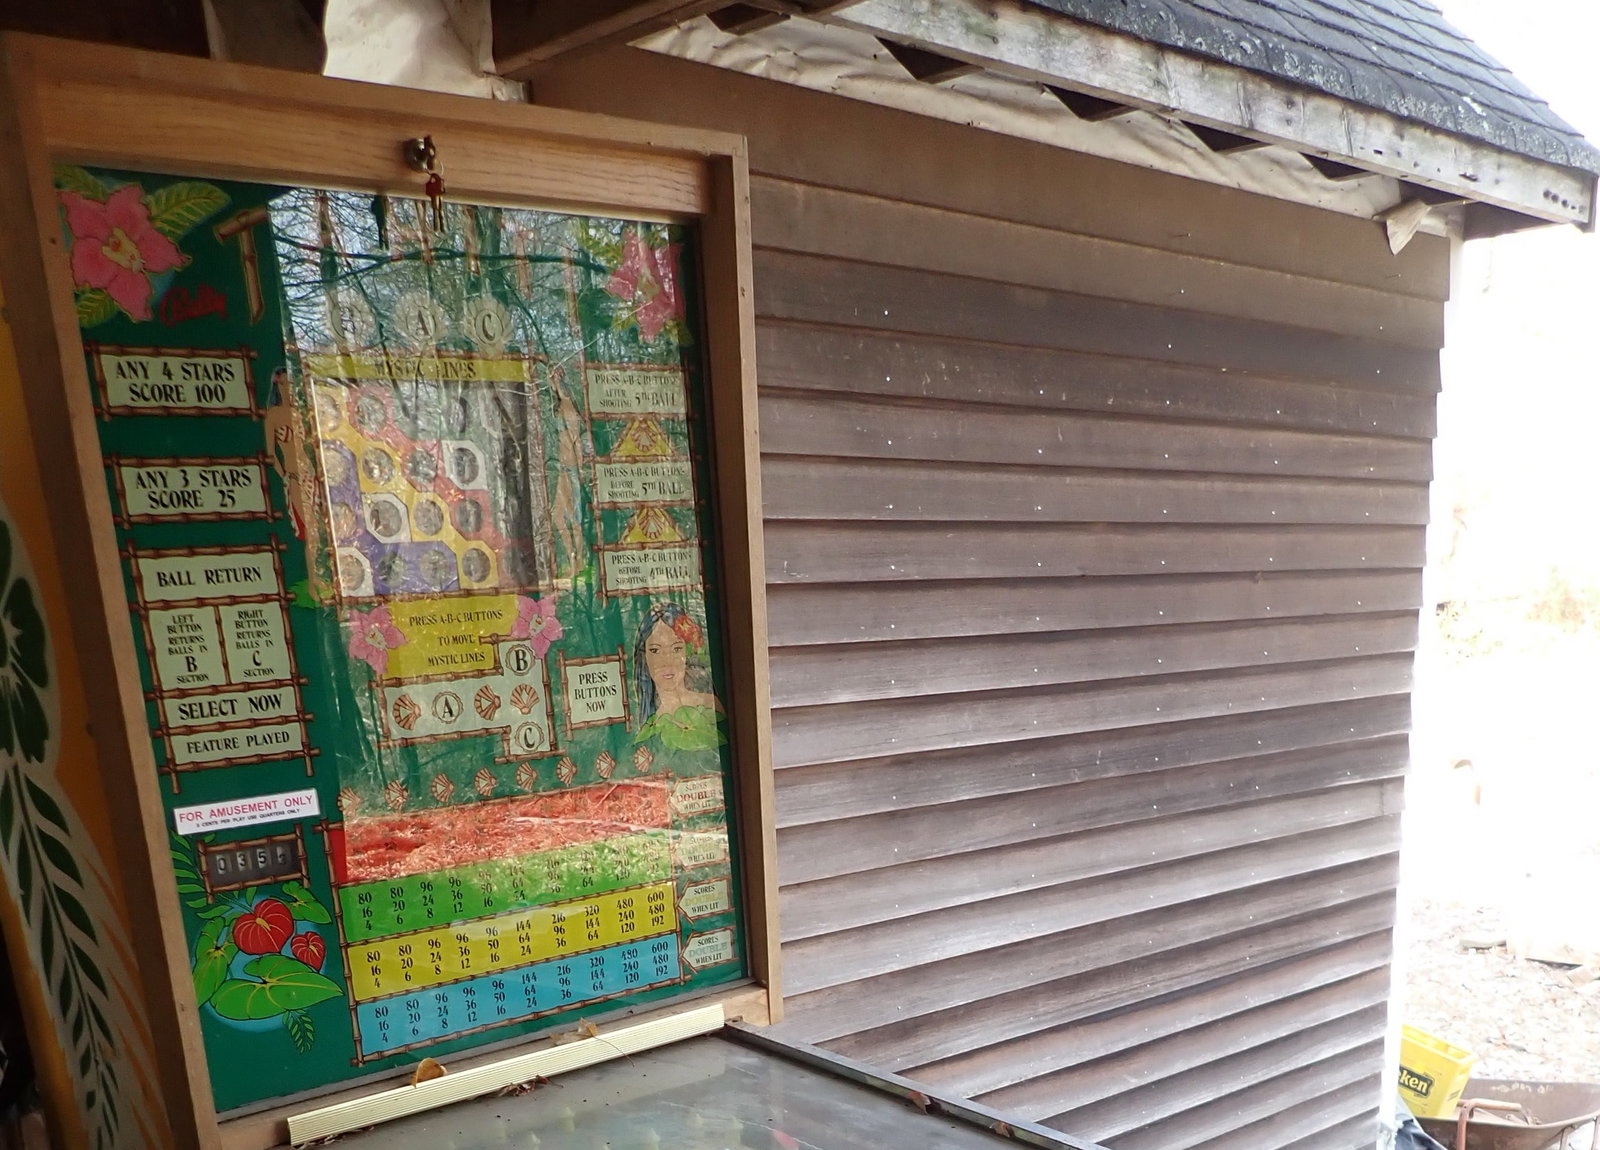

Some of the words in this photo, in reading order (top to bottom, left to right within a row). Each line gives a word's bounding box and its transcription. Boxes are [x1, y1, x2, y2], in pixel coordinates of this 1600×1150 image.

[116, 362, 150, 380] ANY
[163, 362, 174, 379] 4
[182, 363, 234, 381] STARS
[130, 384, 186, 404] SCORE
[195, 384, 225, 404] 100
[136, 470, 169, 489] ANY
[180, 470, 190, 486] 3
[200, 469, 252, 487] STARS
[148, 490, 203, 509] SCORE
[220, 490, 236, 508] 25
[157, 571, 196, 588] BALL
[206, 567, 262, 585] RETURN
[172, 614, 194, 624] LEFT
[238, 610, 263, 618] RIGHT
[410, 616, 438, 626] PRESS
[466, 610, 502, 620] BUTTONS
[167, 624, 202, 633] BUTTON
[236, 620, 268, 628] BUTTON
[168, 635, 204, 644] RETURNS
[236, 630, 270, 639] RETURNS
[438, 636, 450, 645] TO
[453, 634, 474, 644] MOVE
[168, 646, 196, 655] BALLS
[236, 640, 262, 650] BALLS
[186, 656, 197, 672] B
[252, 651, 262, 665] C
[428, 654, 458, 666] MYSTIC
[460, 652, 485, 663] LINES
[516, 650, 527, 671] B
[177, 674, 210, 683] SECTION
[243, 668, 275, 678] SECTION
[579, 672, 608, 684] PRESS
[574, 685, 616, 700] BUTTONS
[178, 700, 237, 720] SELECT
[248, 694, 282, 712] NOW
[443, 698, 454, 718] A
[586, 701, 605, 713] NOW
[187, 738, 239, 753] FEATURE
[247, 731, 289, 746] PLAYED
[524, 728, 535, 748] C
[180, 812, 202, 822] FOR
[210, 800, 278, 818] AMUSEMENT
[285, 796, 312, 807] ONLY
[358, 892, 372, 904] 80
[390, 887, 403, 898] 80
[420, 882, 433, 892] 96
[449, 877, 461, 888] 96
[694, 885, 715, 894] SCORES
[363, 907, 372, 918] 16
[393, 900, 405, 912] 20
[423, 895, 434, 906] 24
[452, 890, 463, 901] 36
[481, 883, 492, 895] 50
[366, 920, 372, 930] 4
[397, 914, 403, 924] 6
[427, 908, 433, 918] 8
[454, 902, 463, 913] 12
[484, 897, 492, 907] 16
[583, 877, 593, 887] 64
[692, 903, 709, 914] WHEN
[710, 902, 718, 910] LIT
[367, 951, 380, 962] 80
[399, 944, 411, 956] 80
[428, 938, 440, 949] 96
[456, 934, 468, 943] 96
[486, 927, 498, 936] 96
[517, 920, 530, 932] 144
[552, 914, 566, 924] 216
[585, 905, 599, 917] 320
[617, 898, 633, 909] 480
[648, 892, 664, 903] 600
[372, 965, 381, 976] 16
[401, 958, 413, 969] 20
[430, 952, 441, 962] 24
[459, 946, 470, 956] 36
[488, 939, 499, 949] 50
[519, 933, 530, 943] 64
[554, 925, 565, 934] 96
[586, 918, 599, 929] 144
[619, 910, 634, 922] 240
[649, 903, 664, 914] 480
[698, 936, 718, 945] SCORES
[375, 978, 380, 988] 4
[405, 972, 411, 981] 6
[435, 966, 441, 975] 8
[462, 958, 470, 969] 12
[491, 953, 499, 962] 16
[521, 945, 531, 956] 24
[556, 938, 566, 948] 36
[588, 930, 598, 940] 64
[622, 922, 634, 933] 120
[652, 916, 664, 926] 192
[689, 944, 728, 958] DOUBLE
[695, 954, 713, 964] WHEN
[714, 952, 722, 960] LIT
[375, 1007, 388, 1018] 80
[406, 999, 419, 1011] 80
[436, 993, 448, 1004] 96
[463, 987, 475, 997] 96
[492, 980, 504, 990] 96
[522, 972, 536, 984] 144
[558, 965, 570, 976] 216
[590, 957, 604, 968] 320
[622, 948, 638, 960] 480
[652, 942, 668, 953] 600
[379, 1020, 389, 1031] 16
[409, 1012, 420, 1023] 20
[438, 1006, 448, 1017] 24
[466, 1000, 476, 1010] 36
[494, 992, 505, 1002] 50
[525, 985, 536, 996] 64
[559, 977, 570, 986] 96
[591, 968, 604, 980] 144
[624, 961, 638, 972] 240
[653, 954, 668, 964] 480
[382, 1033, 388, 1042] 4
[412, 1027, 418, 1036] 6
[442, 1018, 448, 1028] 8
[468, 1011, 477, 1022] 12
[497, 1006, 506, 1015] 16
[527, 997, 536, 1008] 24
[562, 990, 571, 1000] 36
[593, 981, 603, 991] 64
[626, 972, 639, 983] 120
[656, 965, 668, 976] 192
[1398, 1070, 1428, 1093] ken
